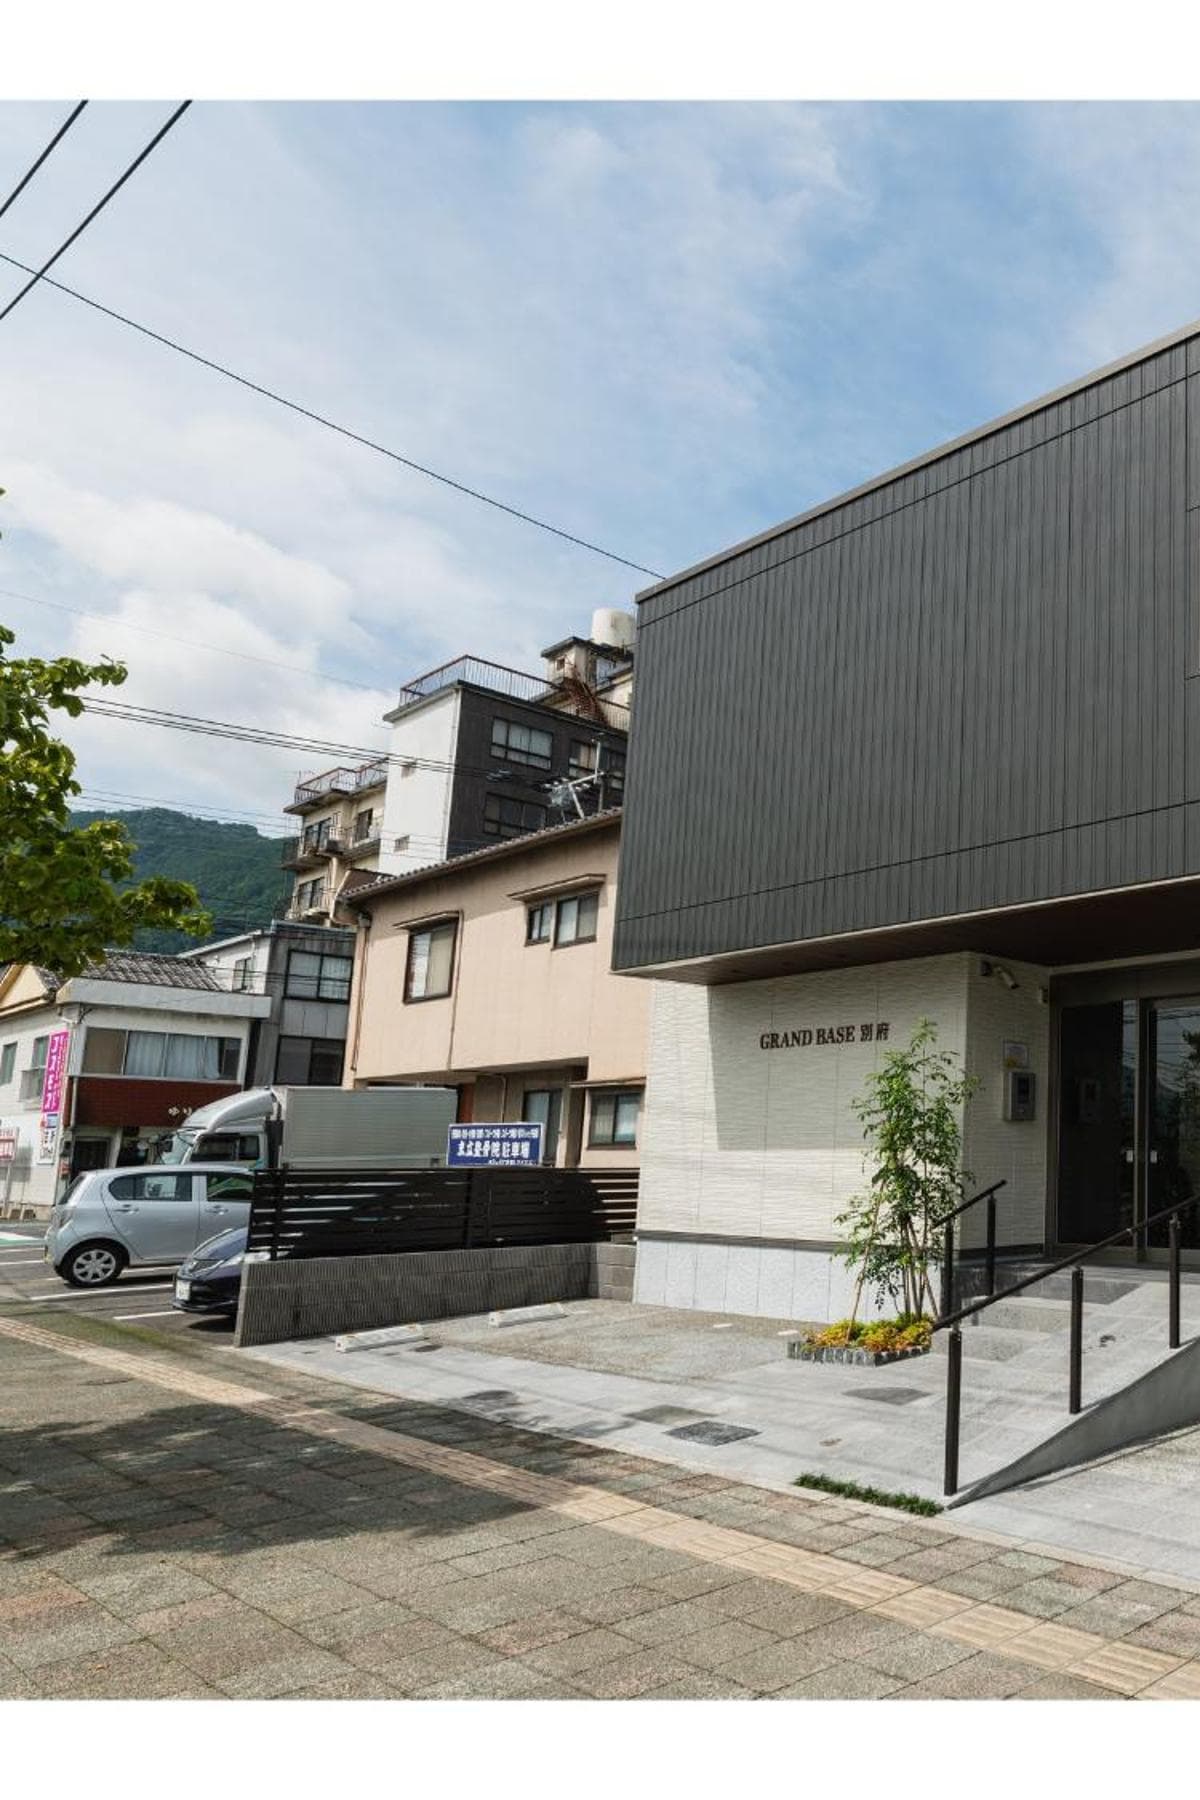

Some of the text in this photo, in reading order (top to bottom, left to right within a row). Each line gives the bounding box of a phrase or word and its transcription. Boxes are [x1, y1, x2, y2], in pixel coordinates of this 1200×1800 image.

[760, 1022, 889, 1050] GRAND BASE 別府
